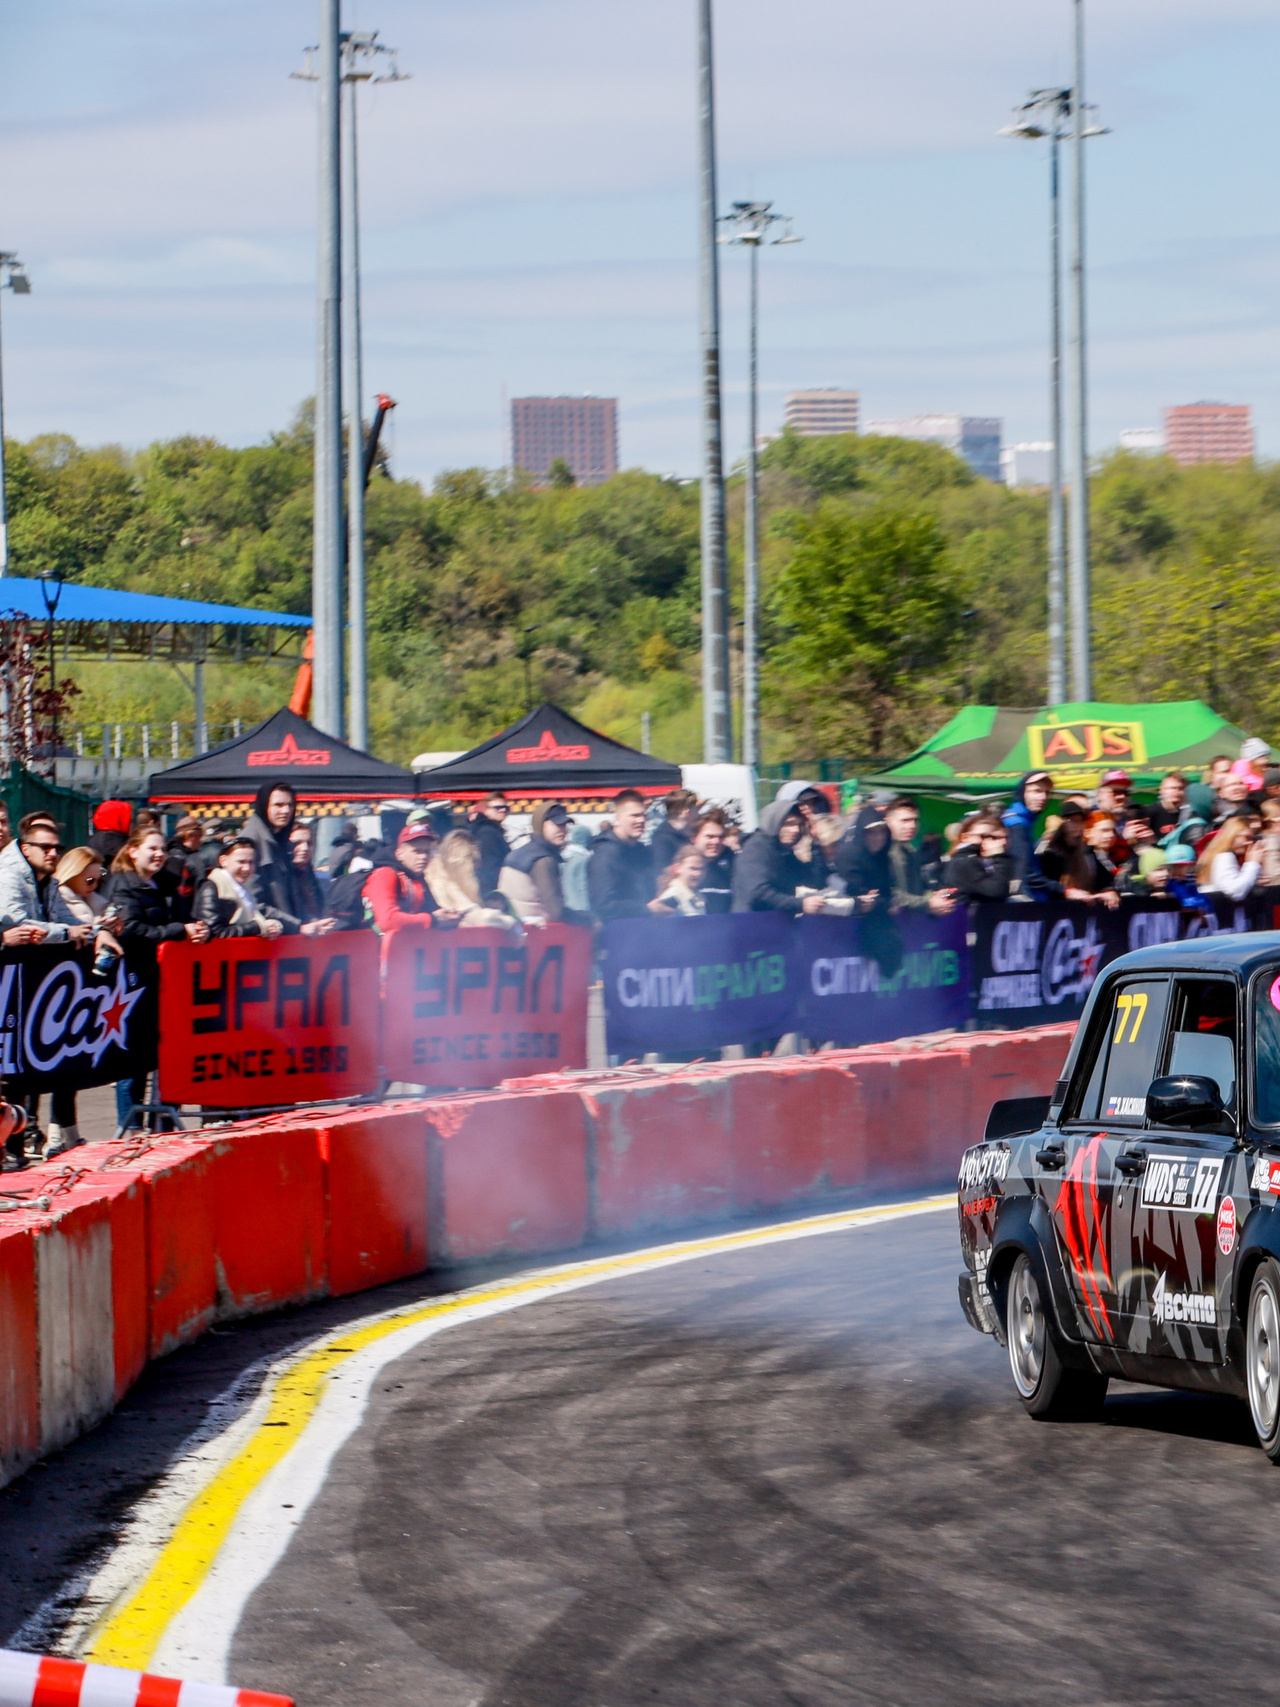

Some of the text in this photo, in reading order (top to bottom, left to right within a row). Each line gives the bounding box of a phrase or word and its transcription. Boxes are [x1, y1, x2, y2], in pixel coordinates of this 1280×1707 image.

[1043, 724, 1133, 762] AJS
[193, 955, 350, 1034] УРАЛ
[414, 945, 564, 1018] УРАЛ
[1113, 992, 1148, 1044] 77
[192, 1049, 274, 1083] SINCE
[413, 1033, 491, 1065] SINCE
[1144, 1161, 1179, 1204] WDS
[1194, 1165, 1219, 1208] 77
